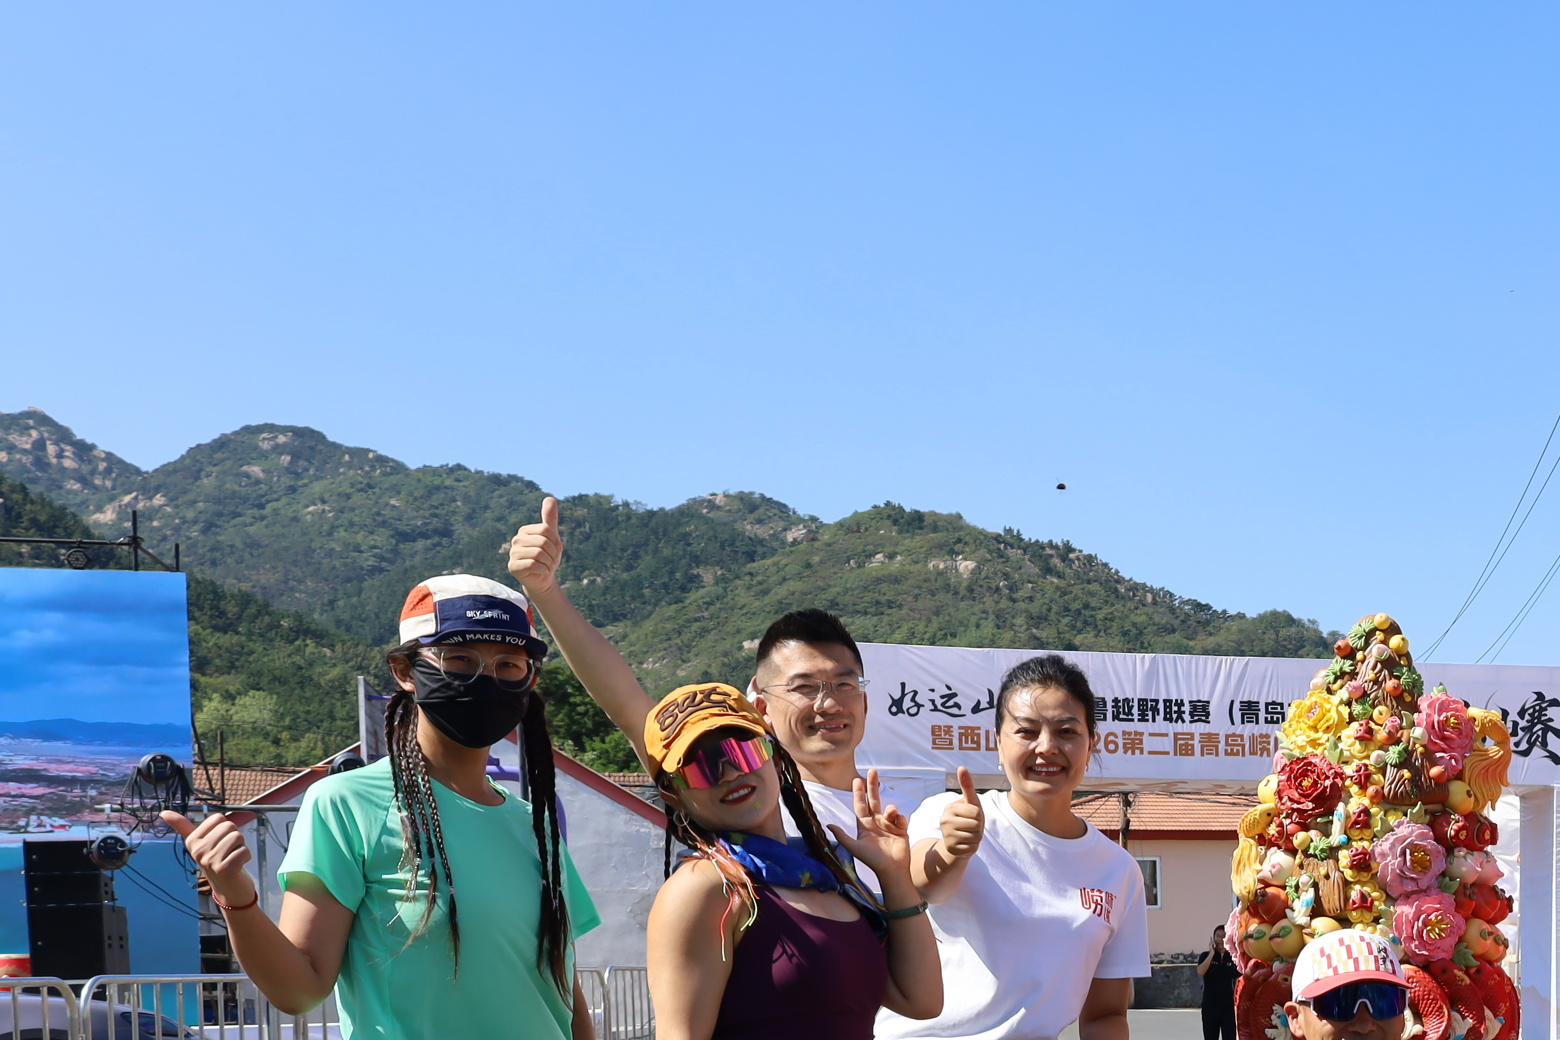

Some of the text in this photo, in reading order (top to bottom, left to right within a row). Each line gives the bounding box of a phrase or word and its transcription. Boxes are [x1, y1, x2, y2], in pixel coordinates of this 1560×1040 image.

[465, 633, 502, 641] MAKES
[505, 635, 526, 646] YOU
[930, 724, 998, 753] 暨西山
